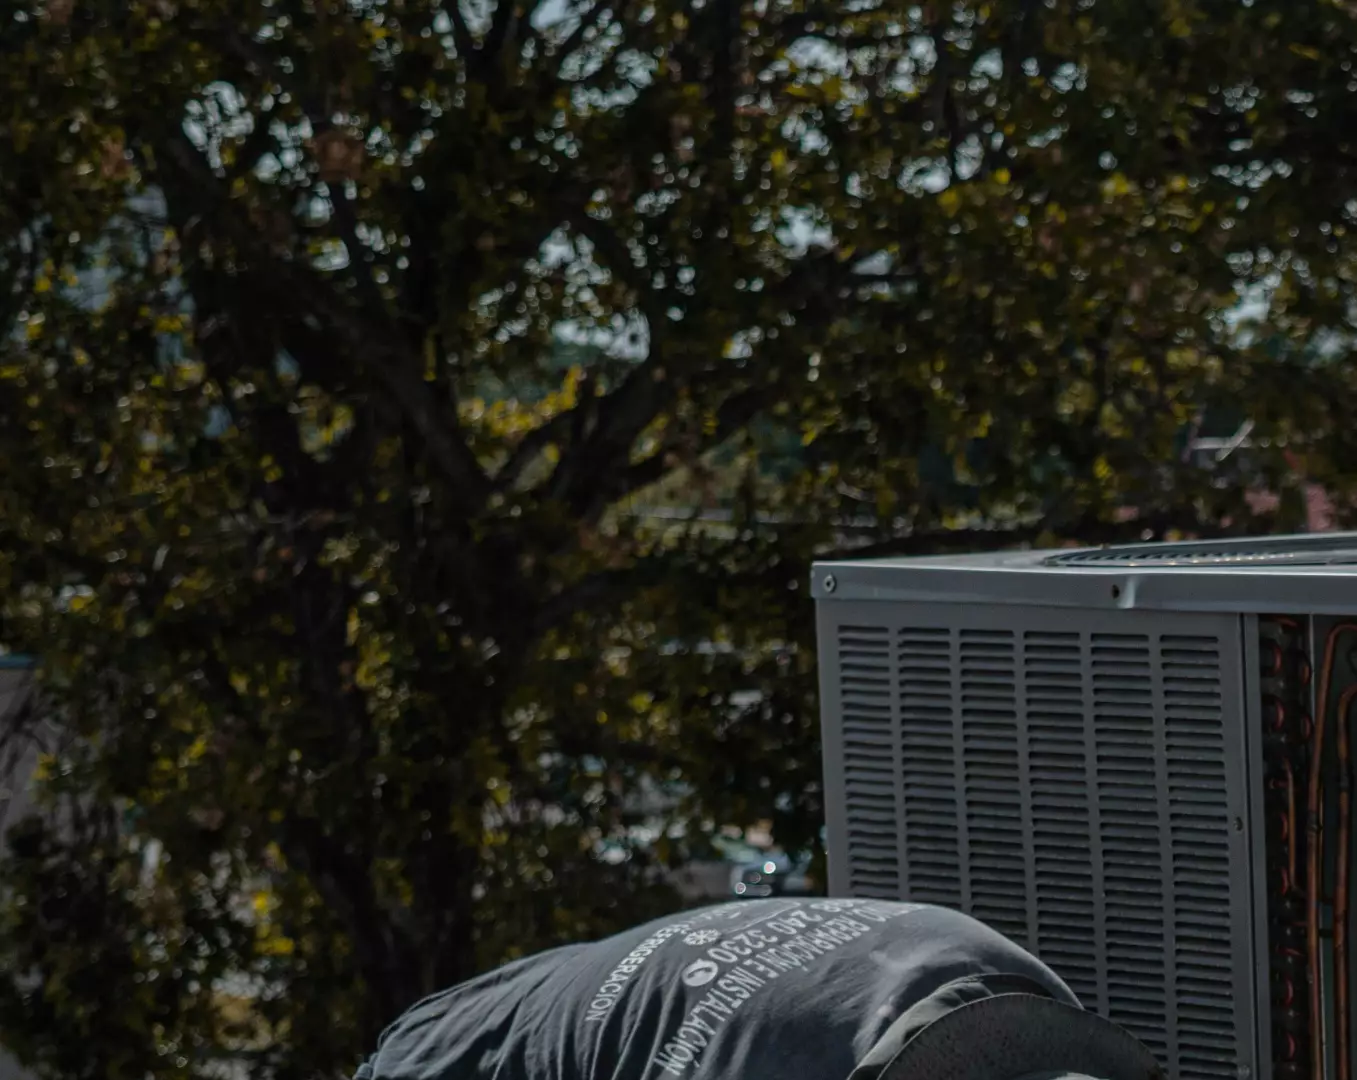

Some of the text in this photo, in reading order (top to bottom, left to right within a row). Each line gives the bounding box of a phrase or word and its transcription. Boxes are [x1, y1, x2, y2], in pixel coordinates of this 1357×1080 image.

[766, 909, 823, 935] 240
[707, 929, 779, 963] 3230
[654, 914, 871, 1076] REPARACIÓN E INSTALACIÓN
